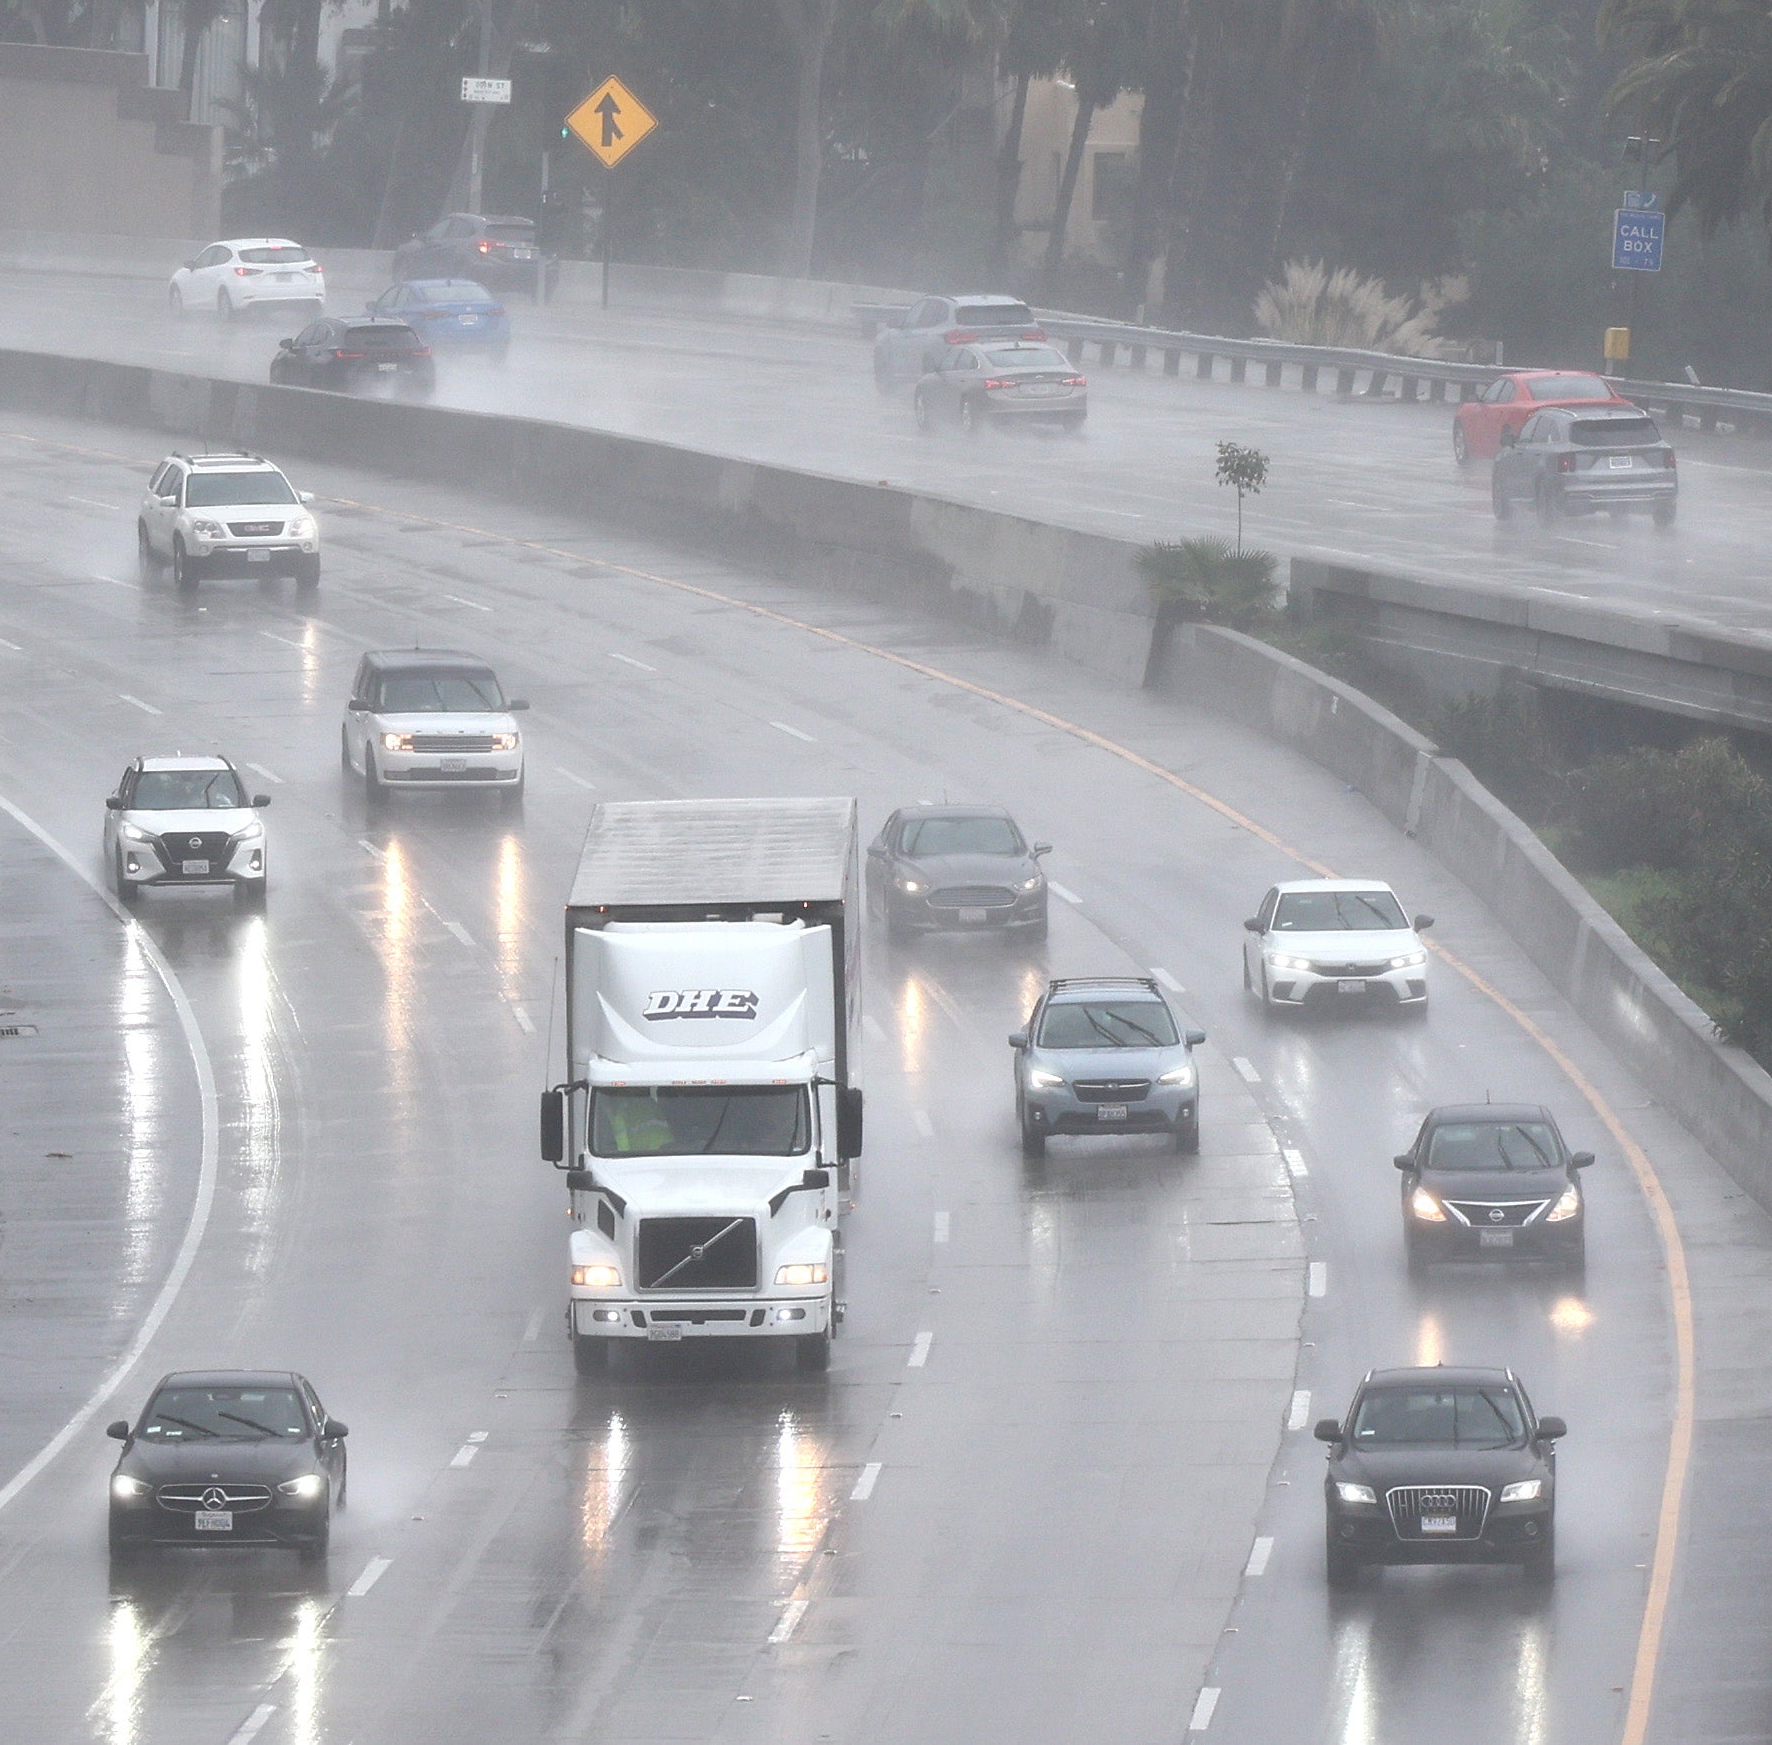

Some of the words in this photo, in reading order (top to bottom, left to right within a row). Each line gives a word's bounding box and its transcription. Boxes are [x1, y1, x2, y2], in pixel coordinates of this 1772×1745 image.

[1620, 225, 1659, 239] CALL
[1623, 240, 1653, 253] BOX
[642, 989, 760, 1022] DHE
